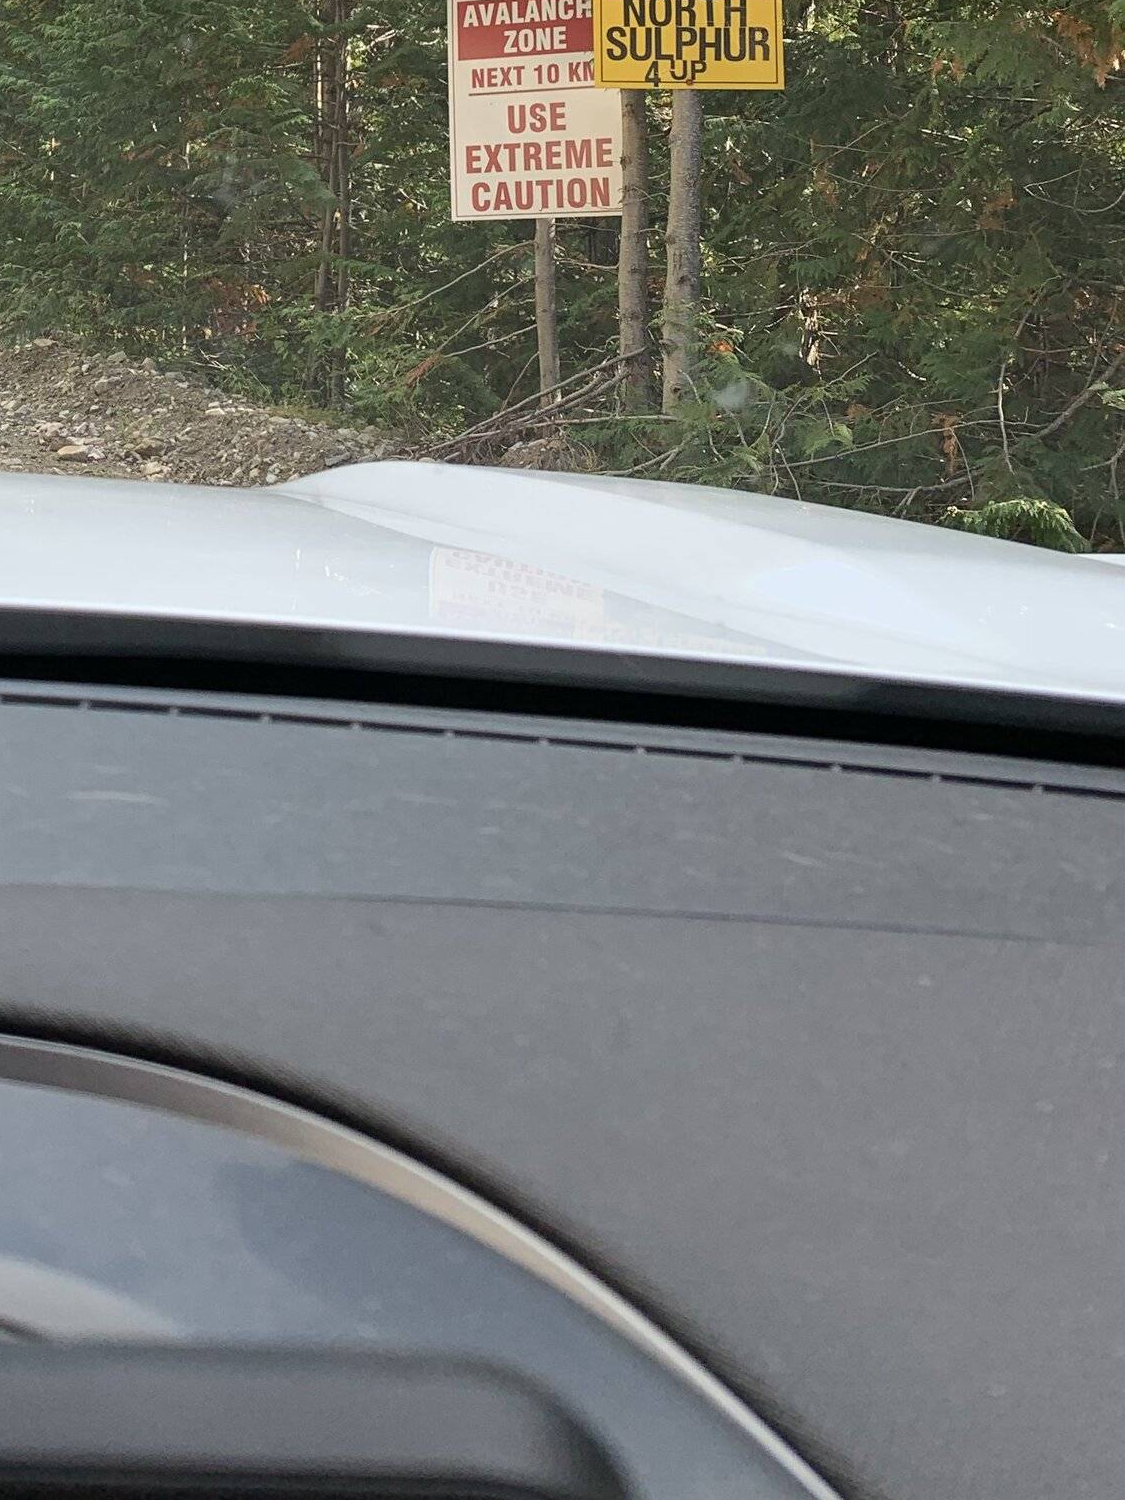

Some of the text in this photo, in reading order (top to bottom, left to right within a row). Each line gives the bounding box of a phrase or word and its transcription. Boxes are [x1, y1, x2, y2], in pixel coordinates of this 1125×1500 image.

[503, 26, 567, 53] ZONE
[606, 26, 770, 62] SULPHUR
[471, 65, 526, 88] NEXT
[533, 63, 560, 85] 10
[644, 59, 707, 88] 4 UP
[507, 102, 567, 134] USE
[465, 137, 613, 175] EXTREME
[471, 177, 610, 212] CAUTION
